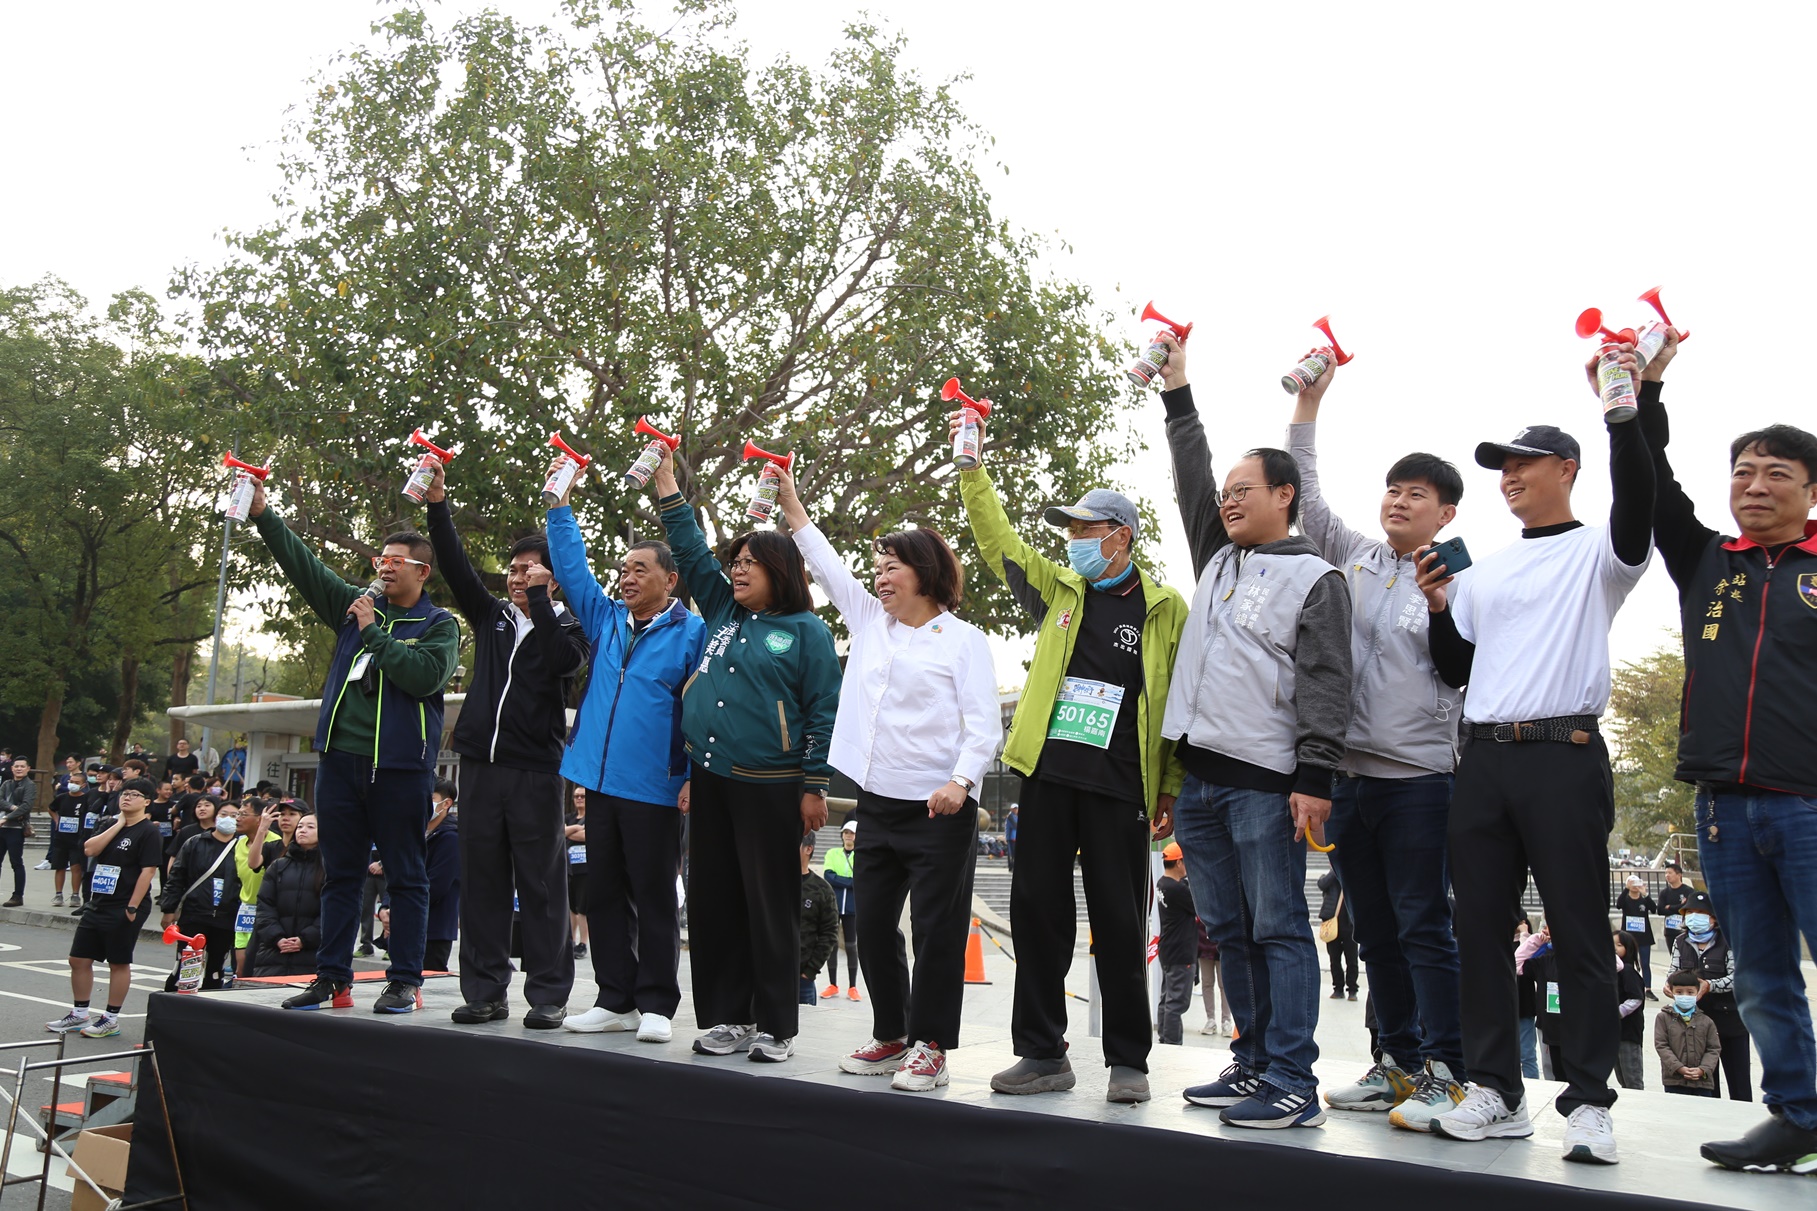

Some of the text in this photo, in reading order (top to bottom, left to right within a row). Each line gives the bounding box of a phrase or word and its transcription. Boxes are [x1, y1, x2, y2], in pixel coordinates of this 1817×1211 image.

[1701, 579, 1730, 641] 余治國
[1056, 705, 1110, 729] 50165
[266, 761, 281, 778] 往
